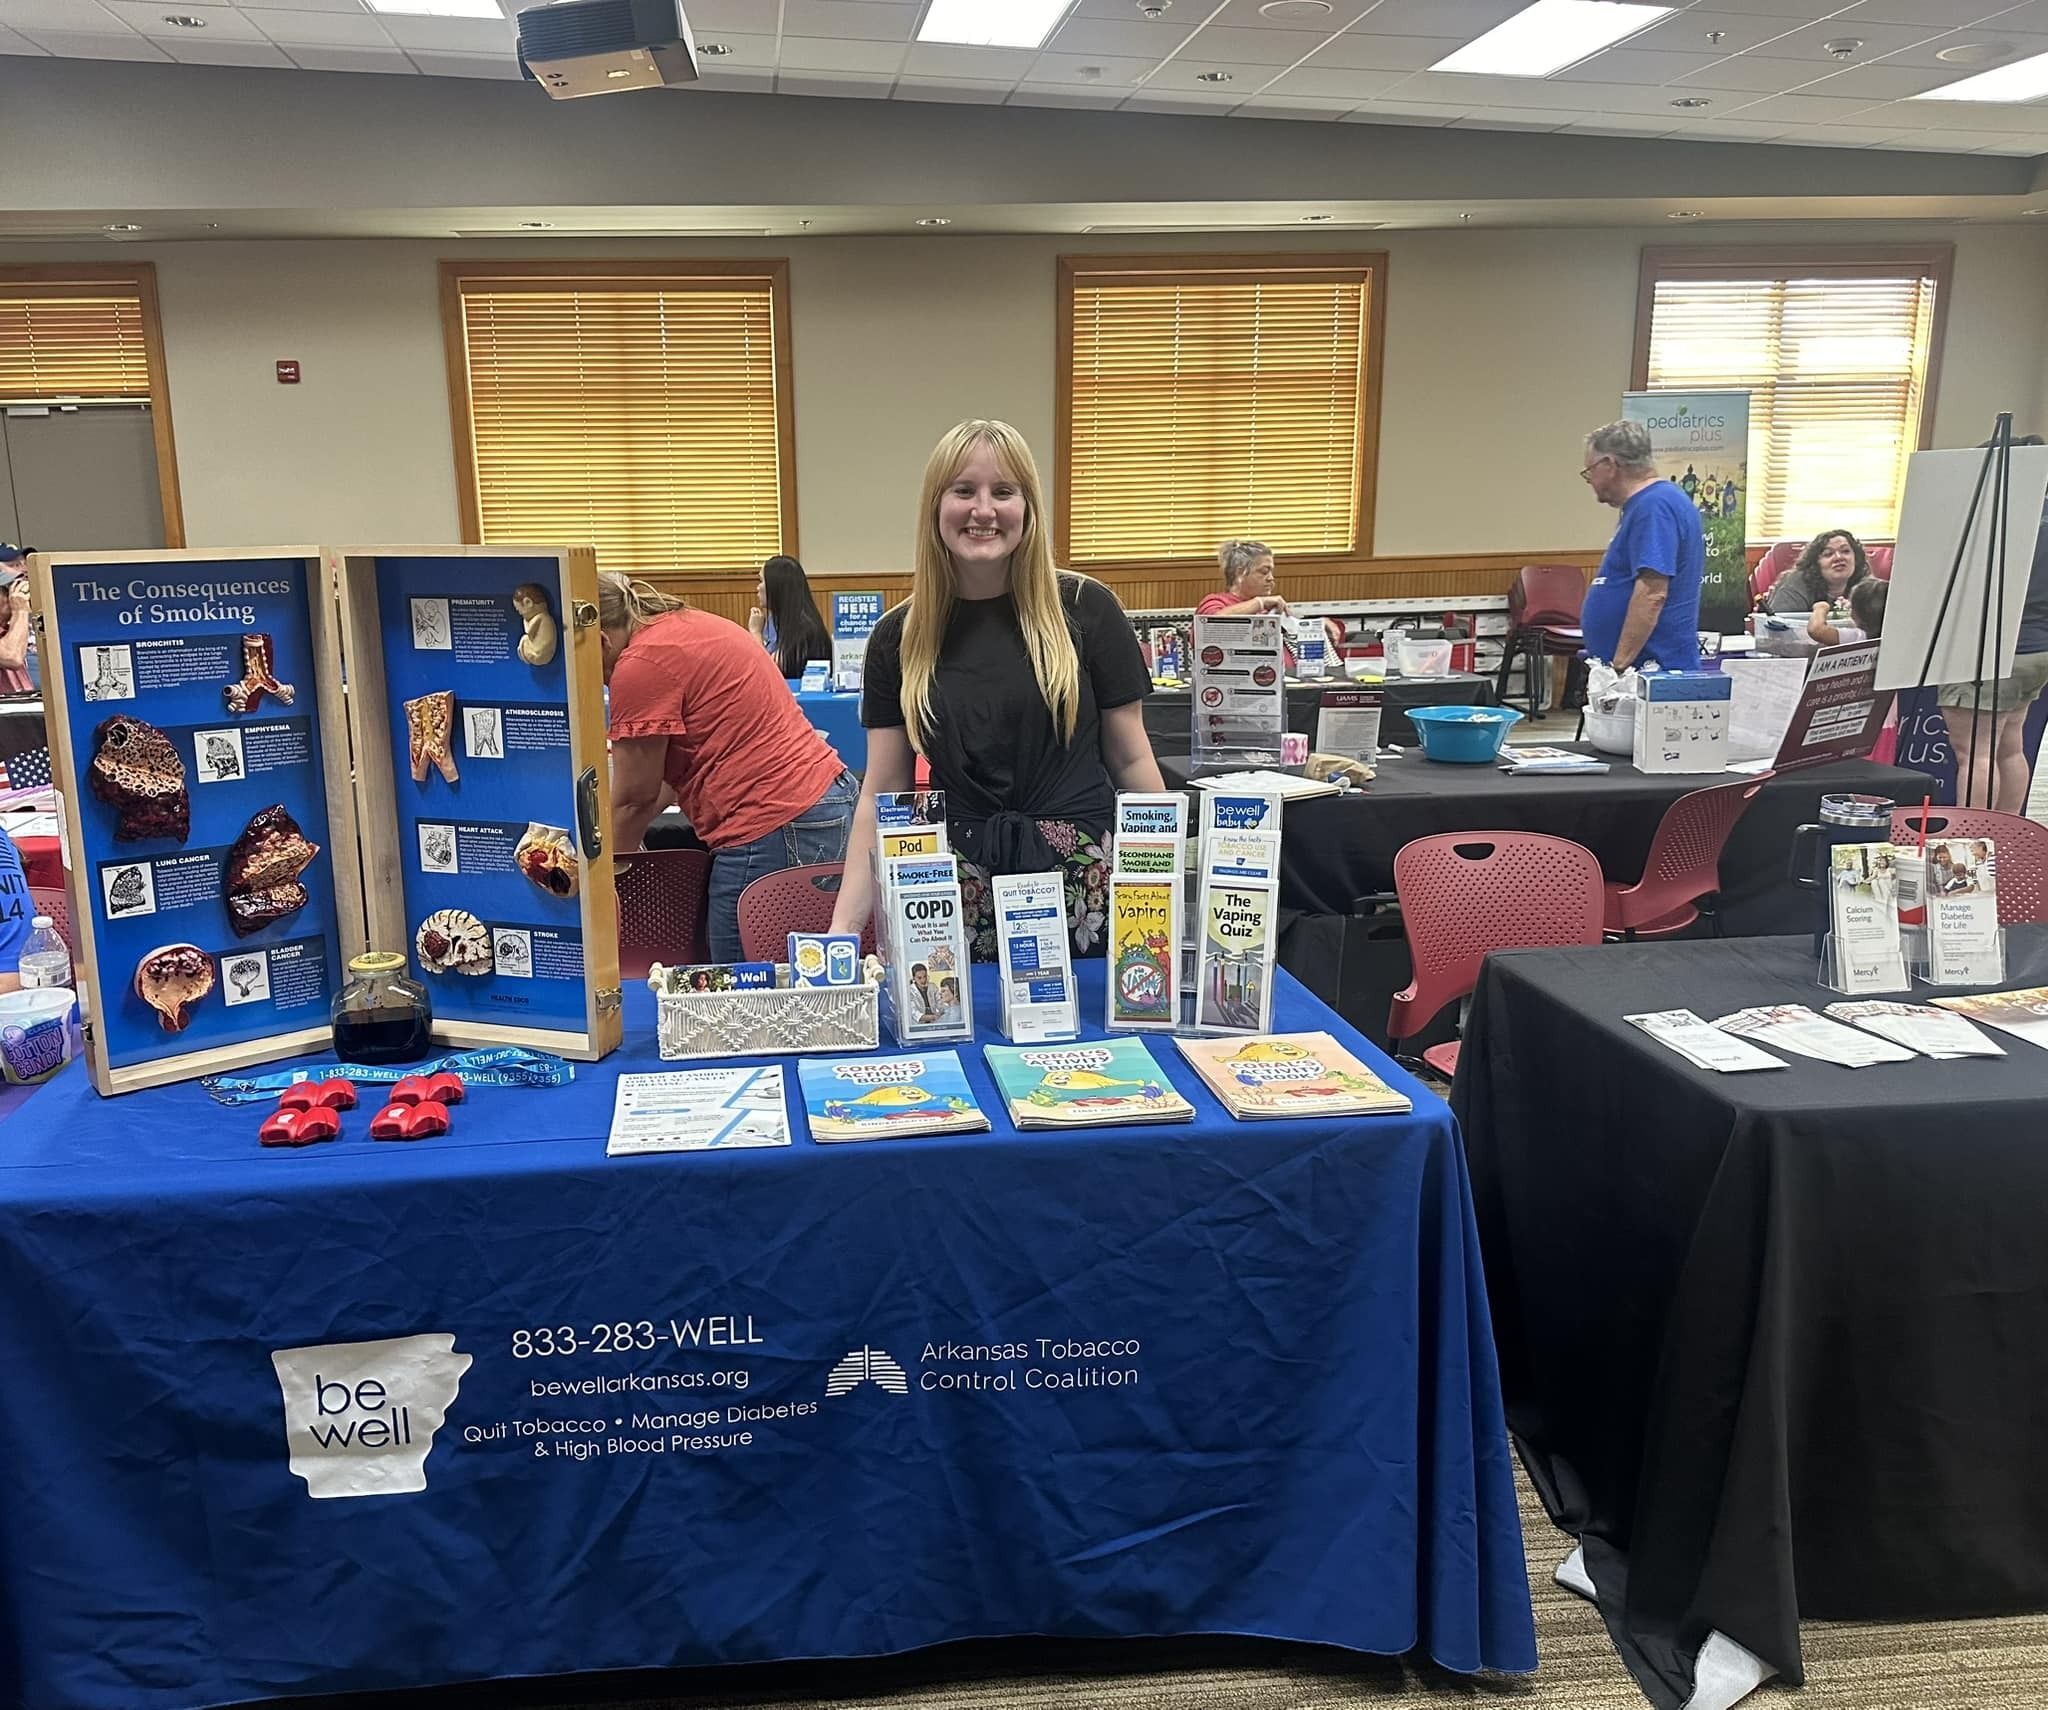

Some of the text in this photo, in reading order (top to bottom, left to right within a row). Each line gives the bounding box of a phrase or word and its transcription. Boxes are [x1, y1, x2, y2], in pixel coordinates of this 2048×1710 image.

[1647, 413, 1725, 432] pediatrics
[1690, 427, 1722, 444] plus
[1706, 546, 1720, 557] to
[72, 579, 290, 601] The Consequences
[838, 595, 877, 603] REGISTER
[118, 602, 256, 625] of Smoking
[838, 602, 878, 614] HERE
[135, 639, 184, 648] BRONCHITIS
[1838, 654, 1867, 669] PATIENT
[505, 709, 564, 717] ATHEROSCLEROSIS
[244, 724, 291, 734] EMPHYSEMA
[1125, 810, 1173, 823] Smoking,
[1216, 814, 1241, 830] baby
[1120, 822, 1178, 833] Vaping and
[899, 839, 922, 852] Pod
[1118, 850, 1175, 859] SECONDHAND
[155, 854, 210, 867] LUNG CANCER
[1121, 859, 1151, 867] SMOKE
[897, 869, 953, 880] SMOKE-FREE
[1018, 886, 1056, 896] TOBACCO?
[1113, 890, 1171, 902] Scary Facts About
[1225, 893, 1251, 907] The
[904, 899, 954, 920] COPD
[1118, 902, 1167, 925] Vaping
[1846, 905, 1874, 914] Calcium
[1940, 903, 1971, 913] Manage
[1213, 907, 1262, 926] Vaping
[1846, 914, 1872, 923] Scoring
[1940, 912, 1975, 920] Diabetes
[938, 920, 949, 928] and
[1941, 921, 1967, 929] for Life
[533, 931, 559, 939] STROKE
[1219, 923, 1253, 938] Quiz
[270, 944, 304, 955] BLADDER
[271, 951, 301, 961] CANCER
[723, 971, 767, 984] Be Well
[1853, 968, 1873, 977] Mercy
[1944, 968, 1965, 977] Mercy
[1024, 1050, 1107, 1060] CORAL'S
[1030, 1056, 1109, 1065] ACTIVITY
[836, 1062, 920, 1073] CORAL'S
[1048, 1063, 1098, 1071] BOOK
[1230, 1060, 1316, 1069] CORAL'S
[319, 1067, 400, 1081] 1-833-283-WELL
[840, 1069, 921, 1078] ACTIVITY
[1240, 1066, 1320, 1075] ACTIVITY
[1260, 1073, 1314, 1081] BOOK
[511, 1315, 764, 1358] 833-283-WELL
[920, 1338, 1140, 1363] Arkansas Tobacco
[530, 1369, 749, 1397] bewellarkansas.org
[920, 1366, 1138, 1391] Control Coalition
[315, 1374, 386, 1416] be
[308, 1406, 411, 1449] well
[463, 1401, 818, 1443] Quit Tobacco Manage Diabetes
[534, 1431, 753, 1461] & High Blood Pressure
